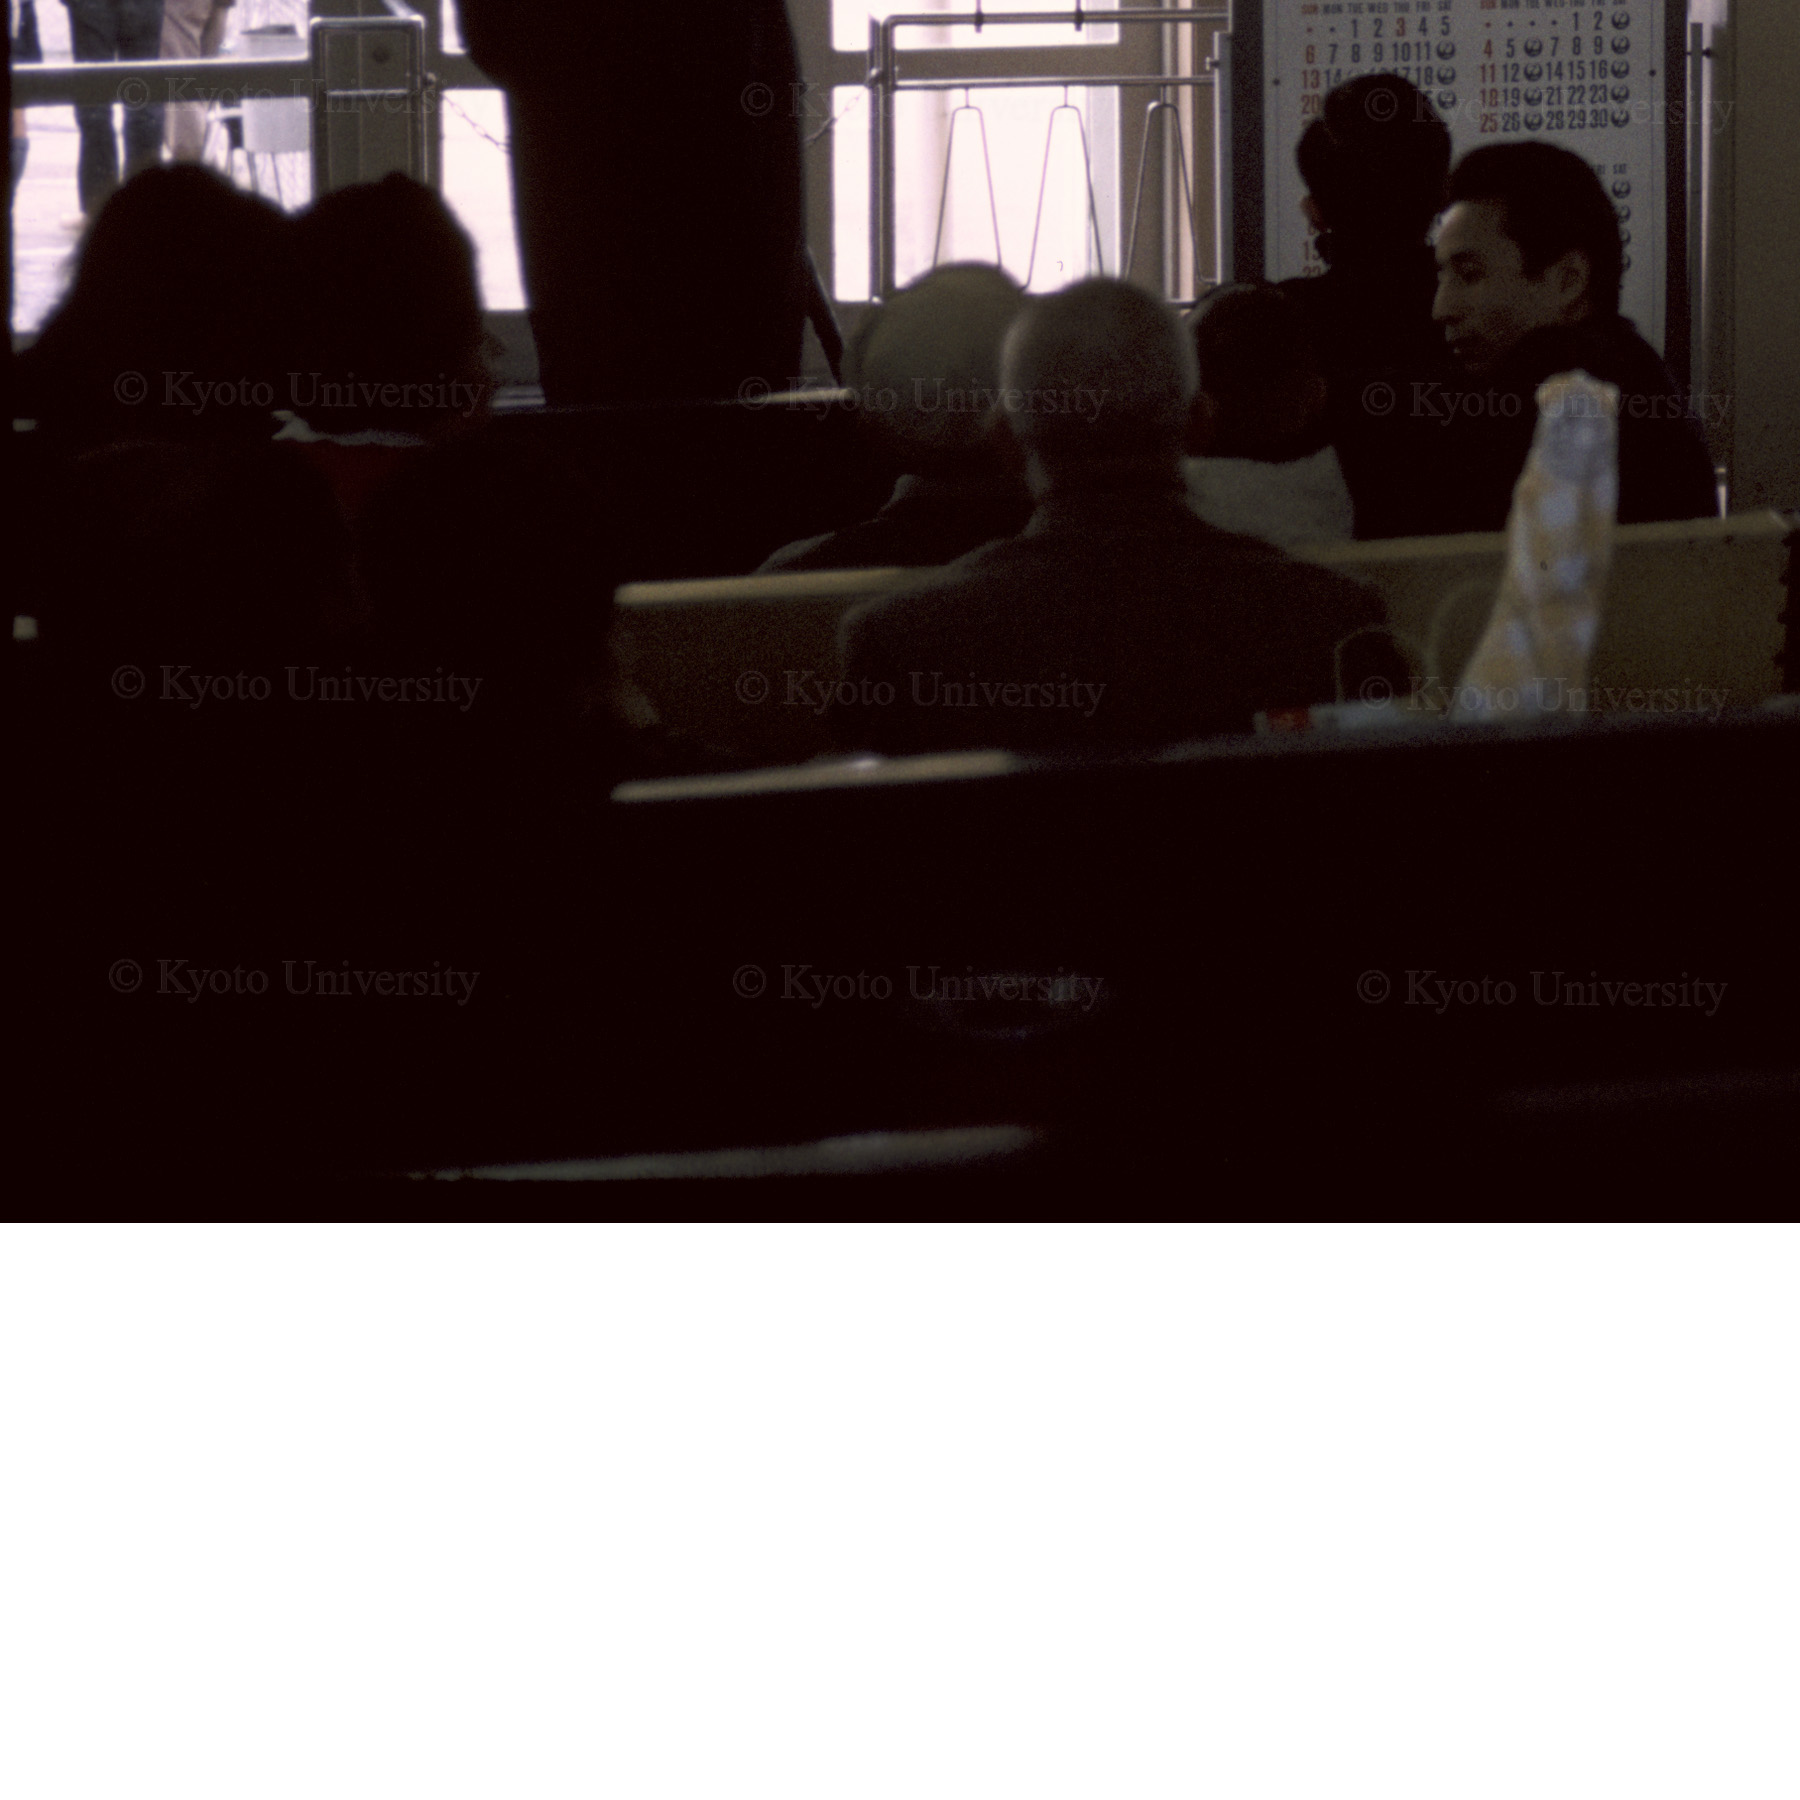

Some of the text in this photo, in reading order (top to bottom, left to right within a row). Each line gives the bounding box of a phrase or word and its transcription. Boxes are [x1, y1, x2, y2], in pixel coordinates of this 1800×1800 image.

[1353, 16, 1450, 38] 1 2 3 4 5
[1573, 11, 1602, 31] 1 2
[1306, 41, 1431, 64] 6 7 8 9 10 11
[1484, 35, 1603, 58] 4 5 7 8 9
[1302, 69, 1320, 89] 13
[1415, 66, 1433, 86] 18
[1480, 59, 1608, 83] 11 12 14 15 16
[1302, 94, 1320, 114] 20
[1480, 84, 1608, 107] 18 19 21 22 23
